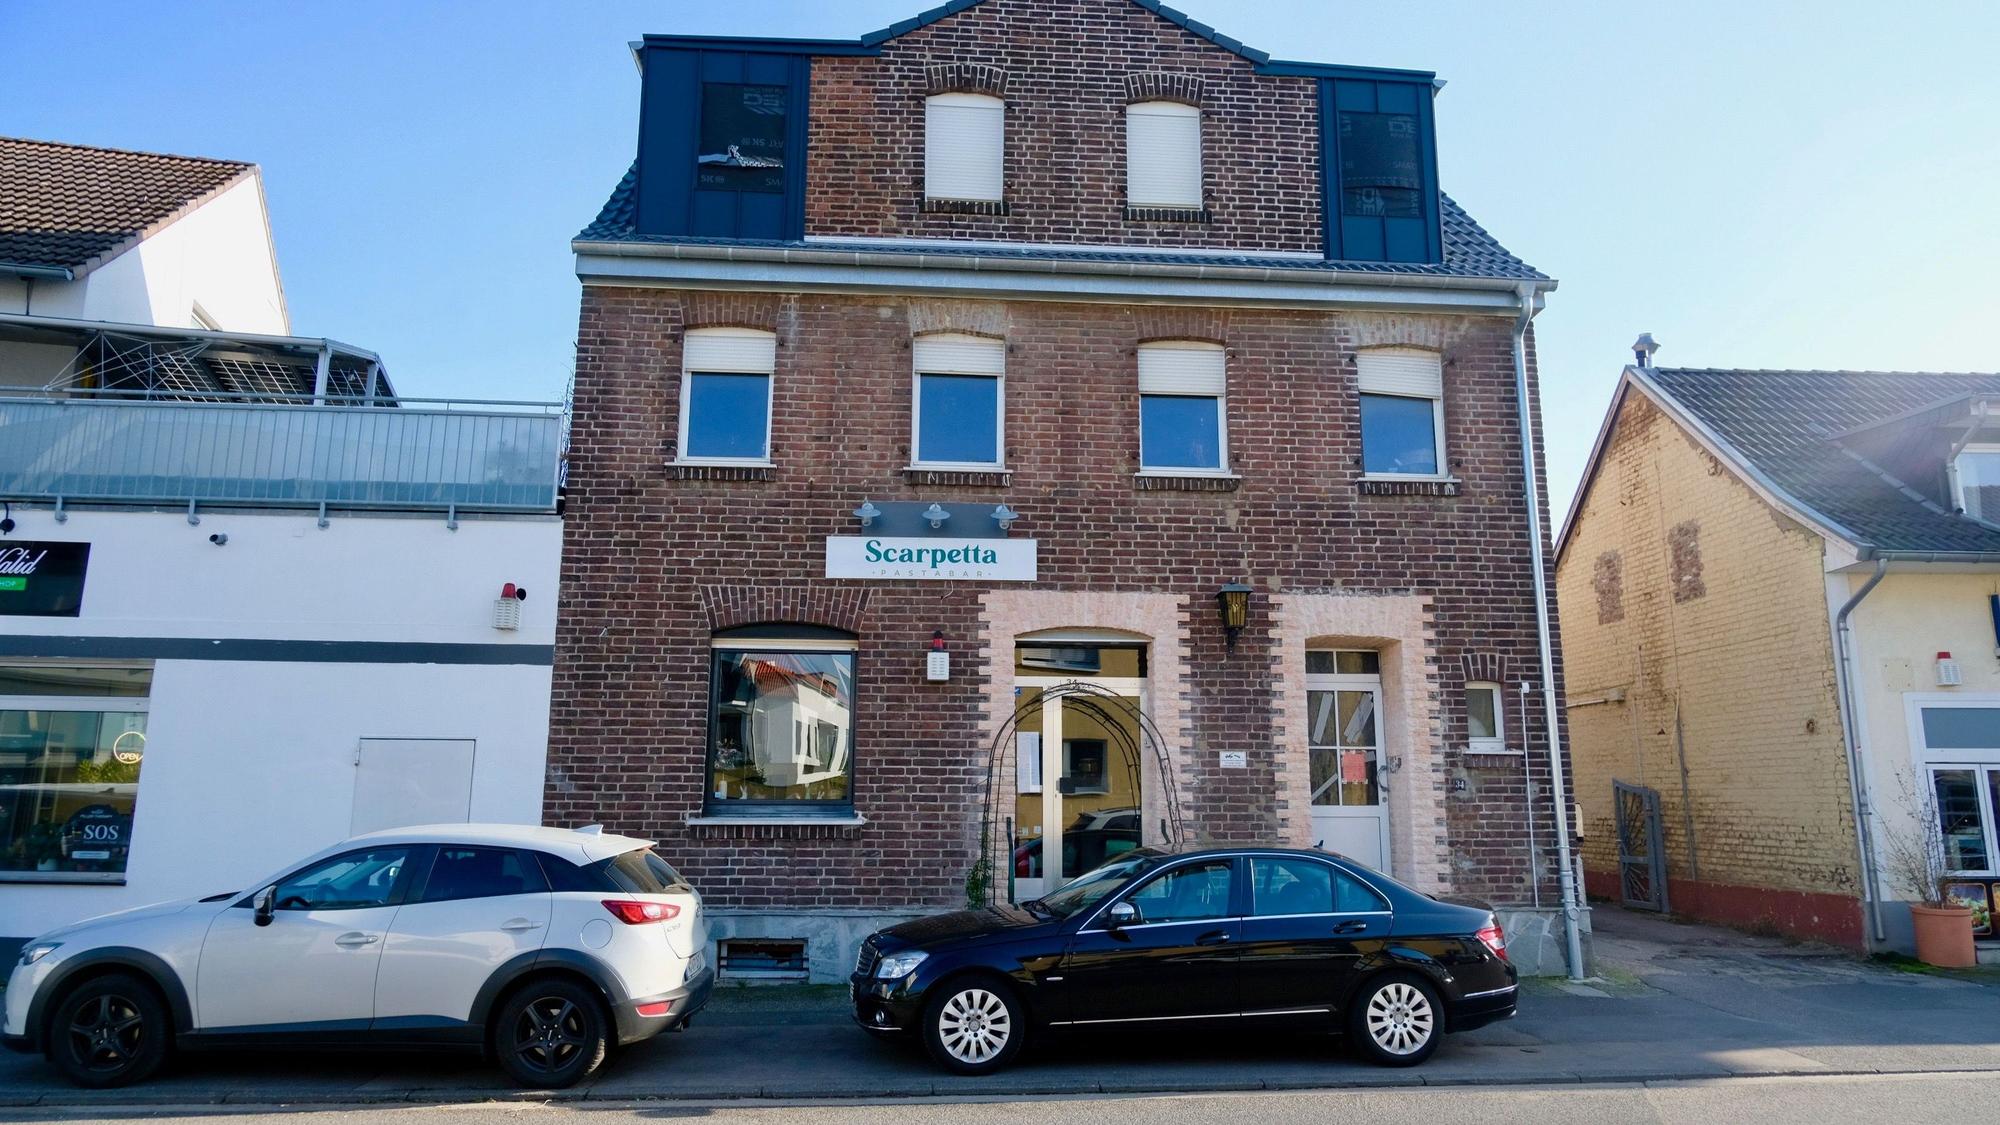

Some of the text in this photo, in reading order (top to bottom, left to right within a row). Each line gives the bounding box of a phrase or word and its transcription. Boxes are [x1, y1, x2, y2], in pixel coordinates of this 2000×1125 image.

[865, 539, 998, 568] Scarpetta
[120, 752, 140, 761] OPEN
[1455, 780, 1465, 790] 34
[83, 824, 120, 840] SOS
